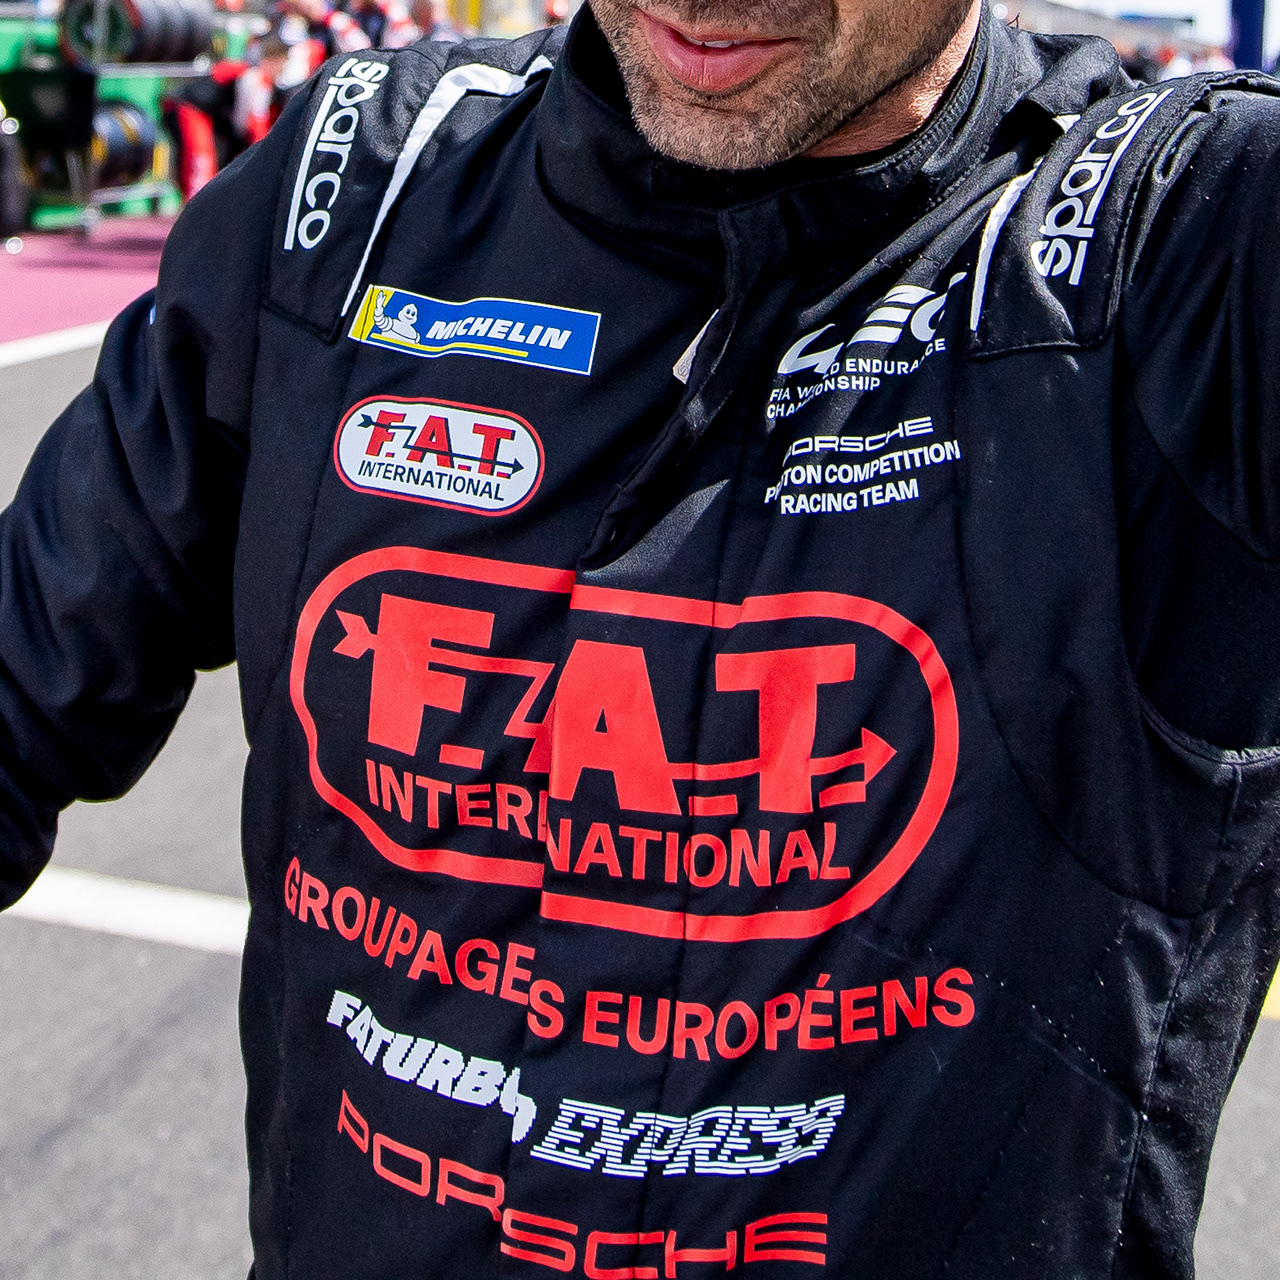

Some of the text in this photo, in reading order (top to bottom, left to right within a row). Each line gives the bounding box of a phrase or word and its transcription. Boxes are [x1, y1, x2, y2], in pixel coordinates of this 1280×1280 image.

[284, 58, 390, 251] sparco
[1030, 87, 1175, 286] sparco
[426, 317, 572, 350] MICHELIN
[769, 388, 790, 402] FIA
[845, 338, 947, 376] ENDURACE
[357, 460, 506, 502] INTERNATIONAL
[780, 478, 920, 515] RACING TEAM
[824, 440, 962, 484] COMPETITION
[366, 760, 851, 888] INTERNATIONAL
[284, 856, 976, 1062] GROUPAGES EUROPÉENS
[530, 1094, 846, 1178] EXPRESS
[337, 1088, 829, 1280] PORSCHE
